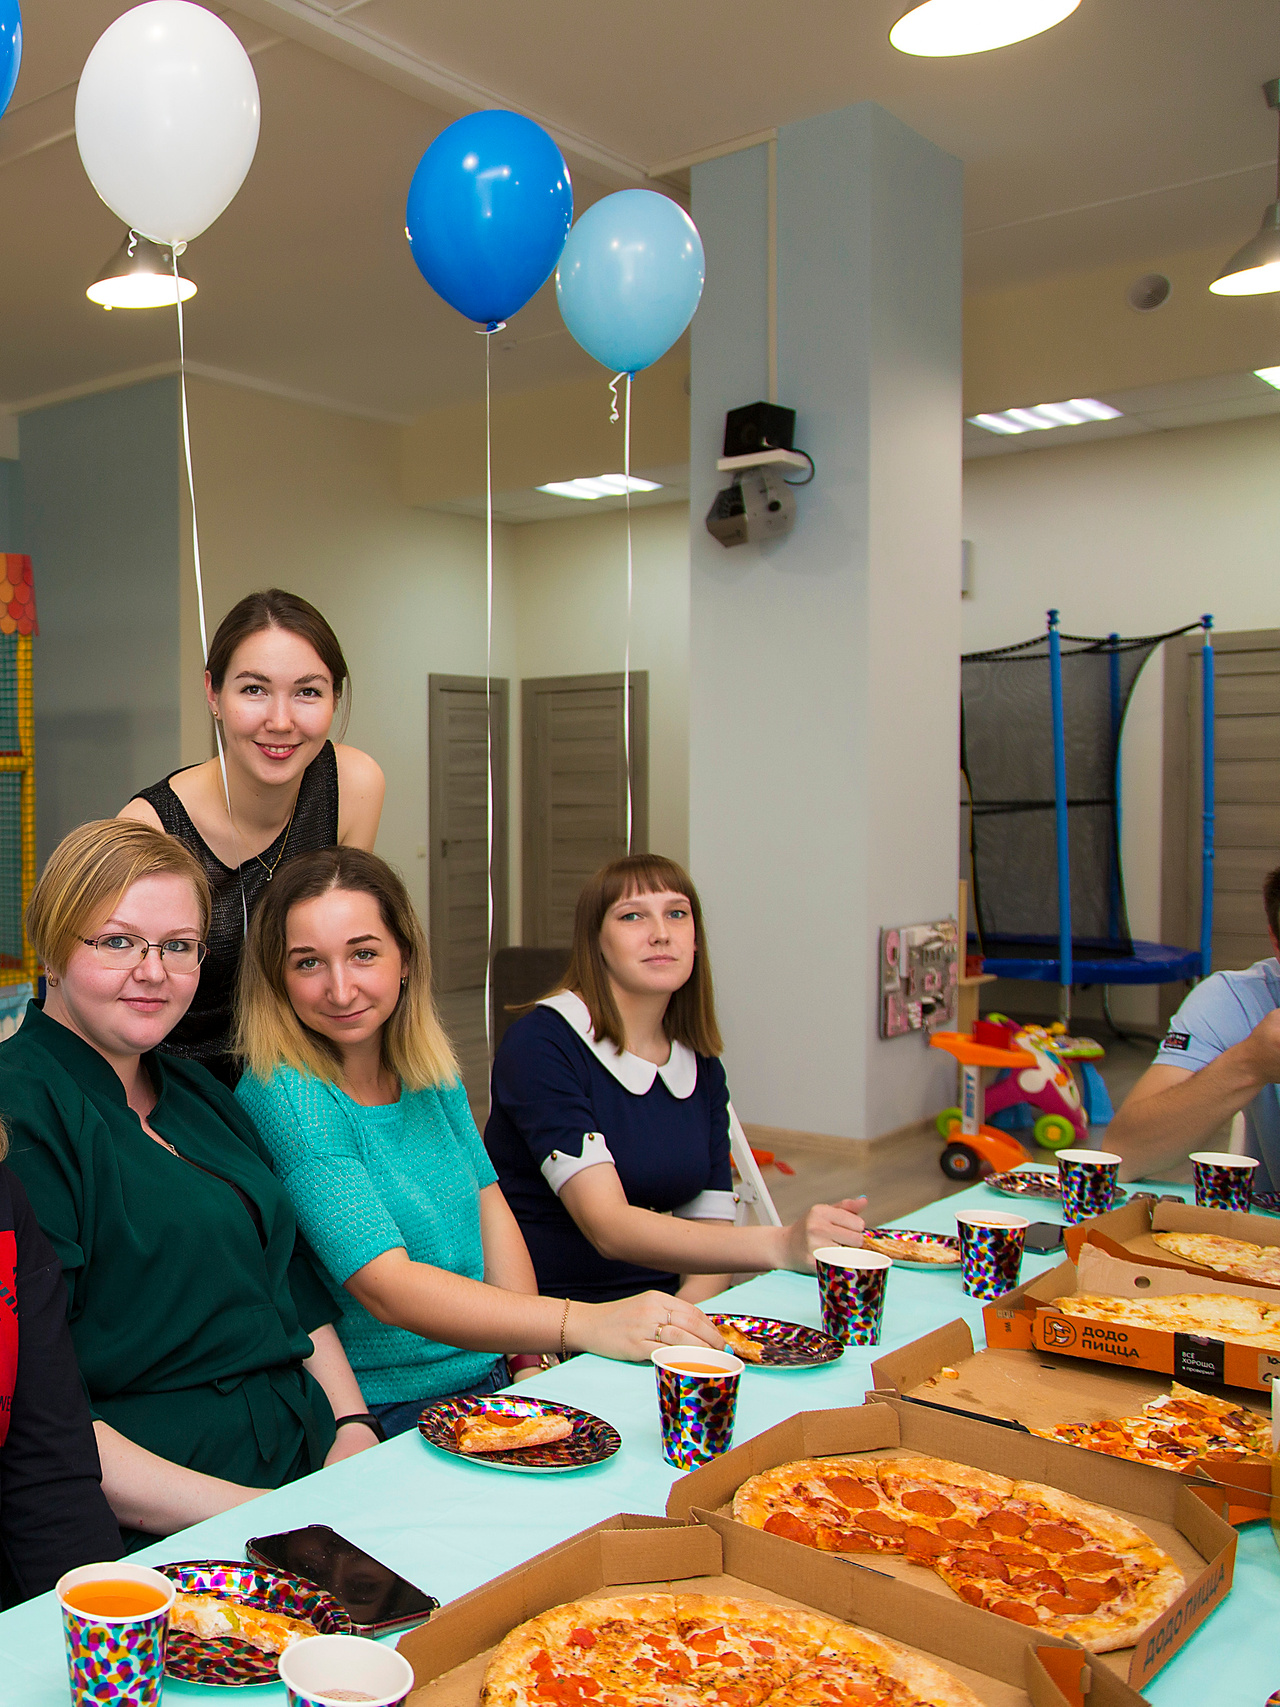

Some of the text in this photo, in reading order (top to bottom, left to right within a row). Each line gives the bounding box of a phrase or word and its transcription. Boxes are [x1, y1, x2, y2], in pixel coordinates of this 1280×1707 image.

[1082, 1326, 1129, 1342] ДОДО
[1082, 1339, 1140, 1358] ПИЦЦА
[1143, 1562, 1225, 1673] ДОДО ПИЦЦА
